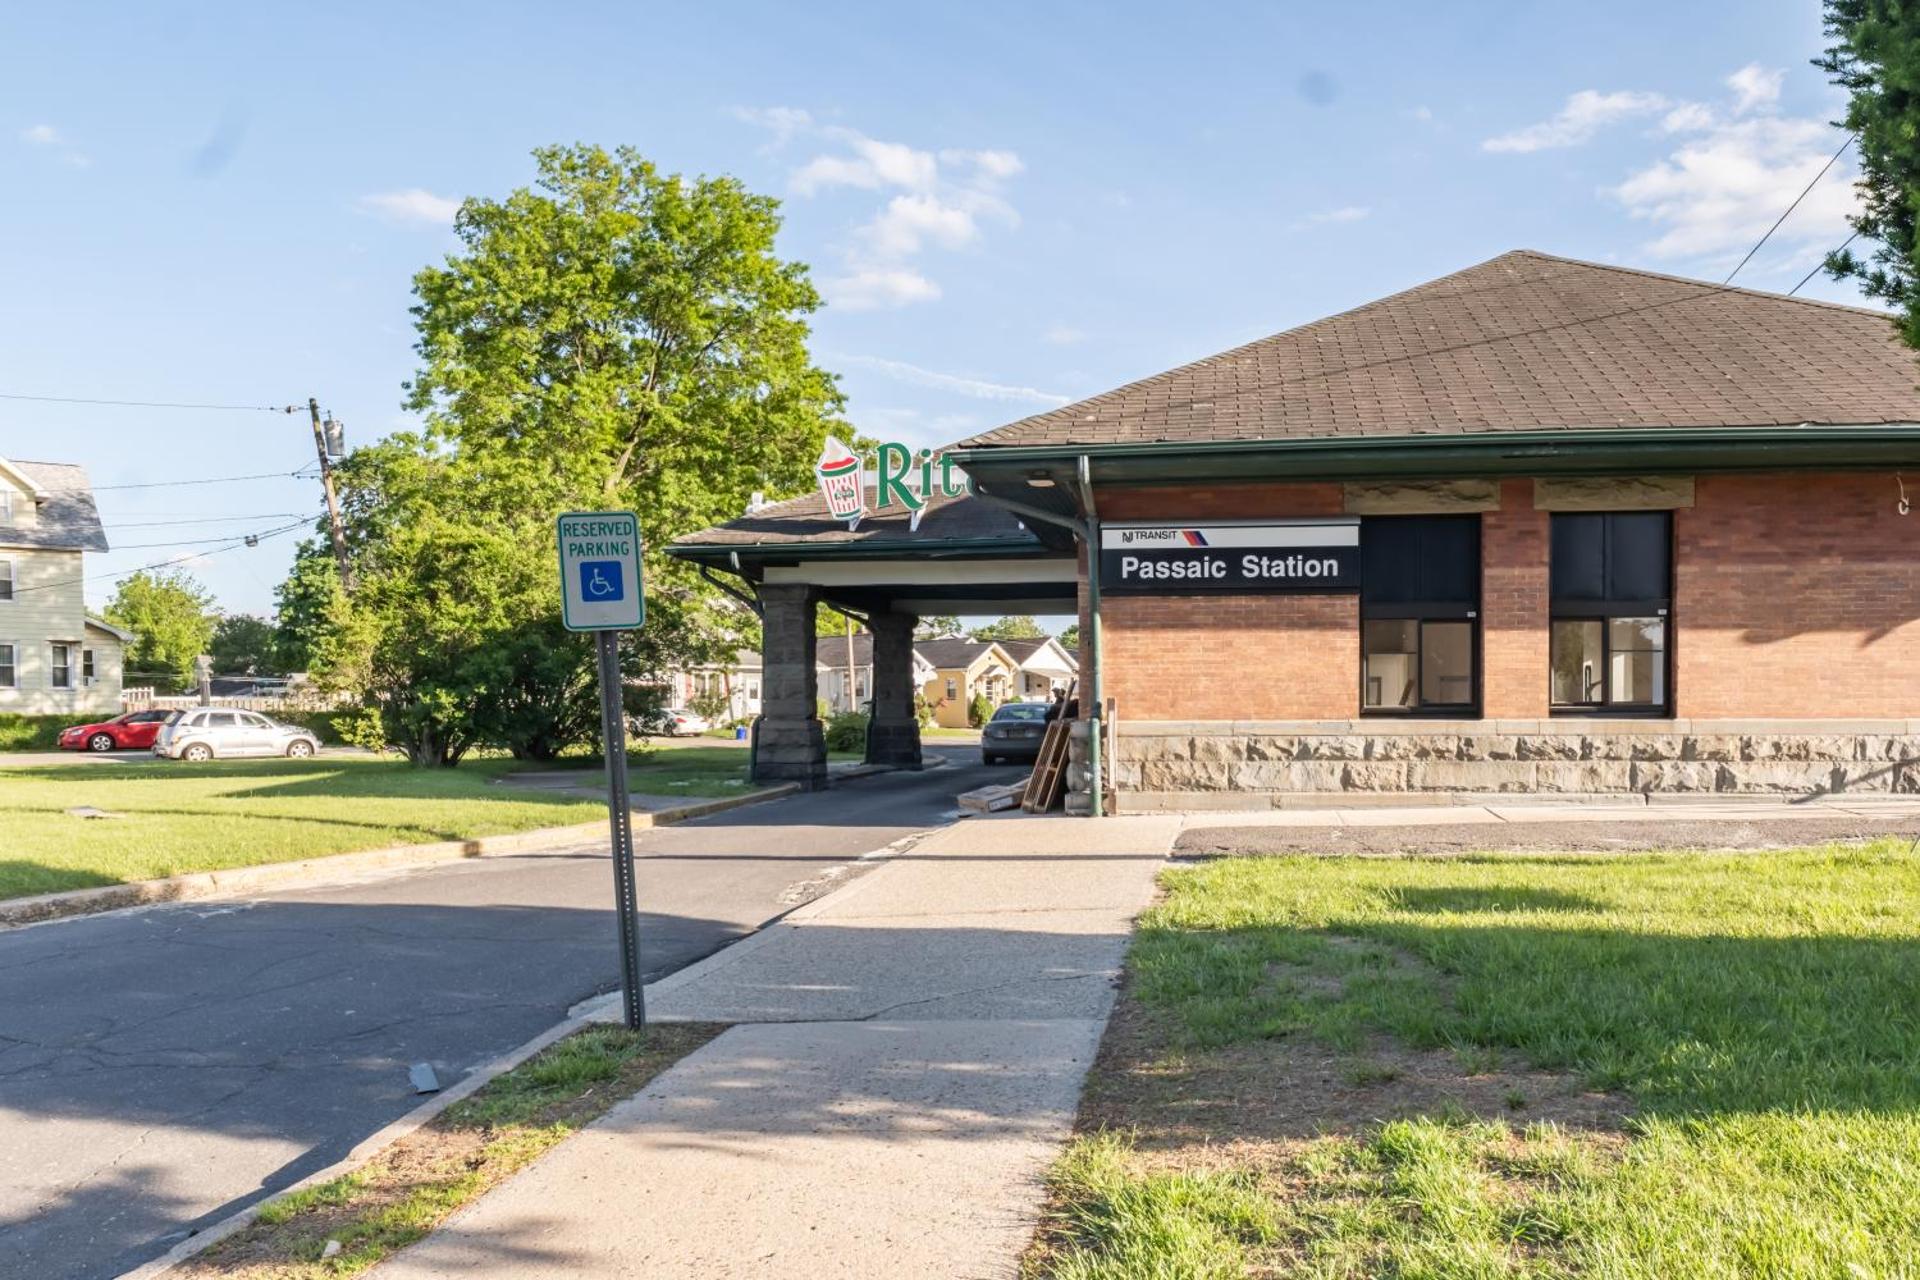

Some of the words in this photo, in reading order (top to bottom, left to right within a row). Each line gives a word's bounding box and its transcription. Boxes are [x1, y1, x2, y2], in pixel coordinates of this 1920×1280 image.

[876, 442, 973, 511] Rit
[563, 521, 633, 537] RESERVED
[1134, 530, 1178, 541] TRANSIT
[569, 541, 630, 557] PARKING
[1121, 555, 1227, 579] Passaic
[1241, 554, 1339, 578] Station
